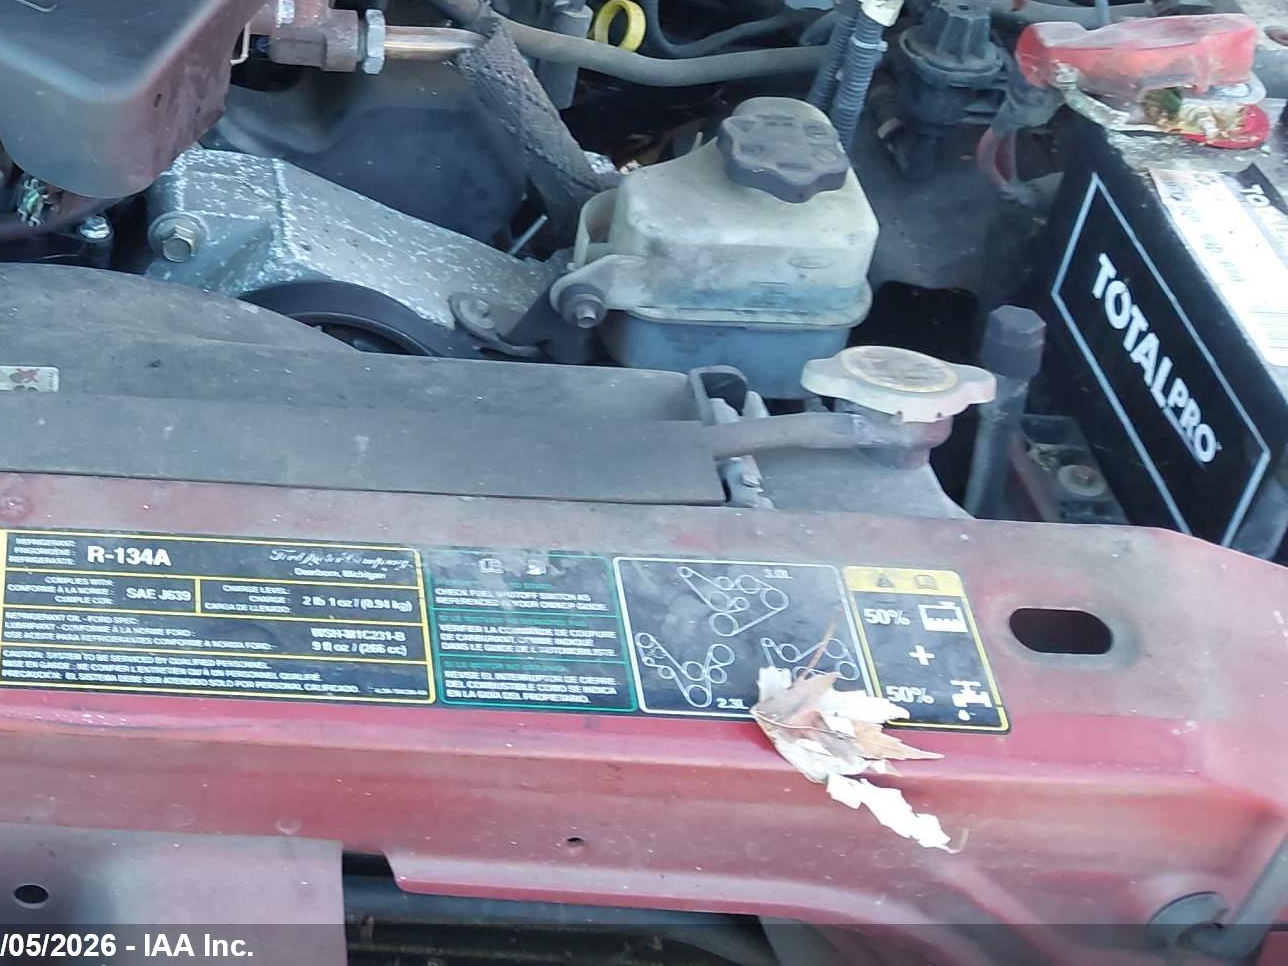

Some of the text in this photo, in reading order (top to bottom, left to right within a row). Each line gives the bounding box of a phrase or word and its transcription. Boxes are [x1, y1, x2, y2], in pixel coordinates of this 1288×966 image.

[1092, 252, 1216, 464] TOTALPRO
[87, 545, 172, 567] R-134A
[126, 588, 192, 602] SAE J639
[302, 596, 311, 606] 2
[863, 608, 911, 627] 50%
[886, 685, 935, 705] 50%
